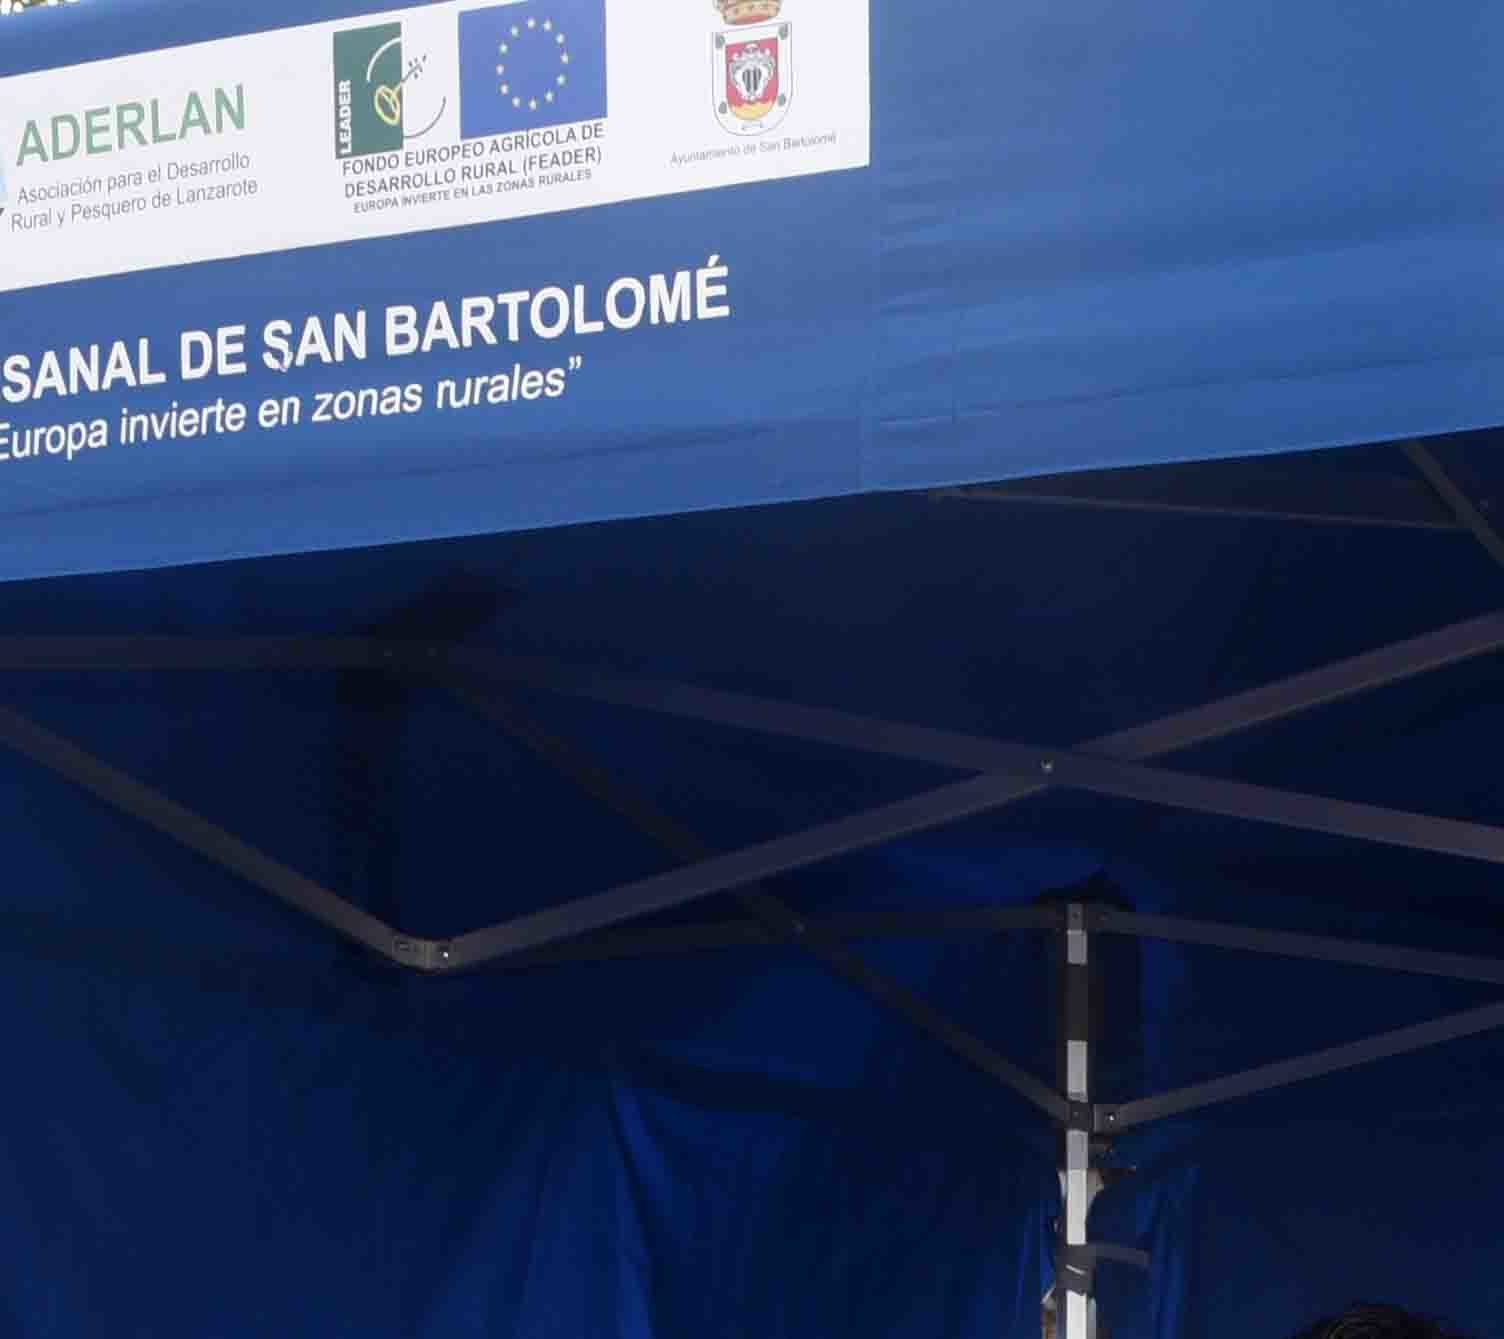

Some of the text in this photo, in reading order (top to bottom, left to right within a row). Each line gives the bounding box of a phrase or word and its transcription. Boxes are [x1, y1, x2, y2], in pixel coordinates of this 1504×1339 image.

[16, 83, 245, 166] ADERLAN
[339, 80, 352, 155] LEADER
[342, 122, 604, 177] FONDO EUROPEO AGRÍCOLA DE
[344, 145, 602, 199] DESARROLLO RURAL (FEADER)
[11, 176, 258, 232] Rural y Pesquero de Lanzarote
[17, 152, 251, 205] Asociación para el Desarrollo
[353, 168, 592, 214] EUROPA INVIERTE EN LAS ZONAS RURALES
[181, 324, 247, 380] DE
[262, 310, 367, 371] SAN
[386, 255, 729, 356] BARTOLOMÉ
[121, 398, 245, 444] invierte
[257, 395, 300, 427] en
[312, 381, 423, 422] zonas
